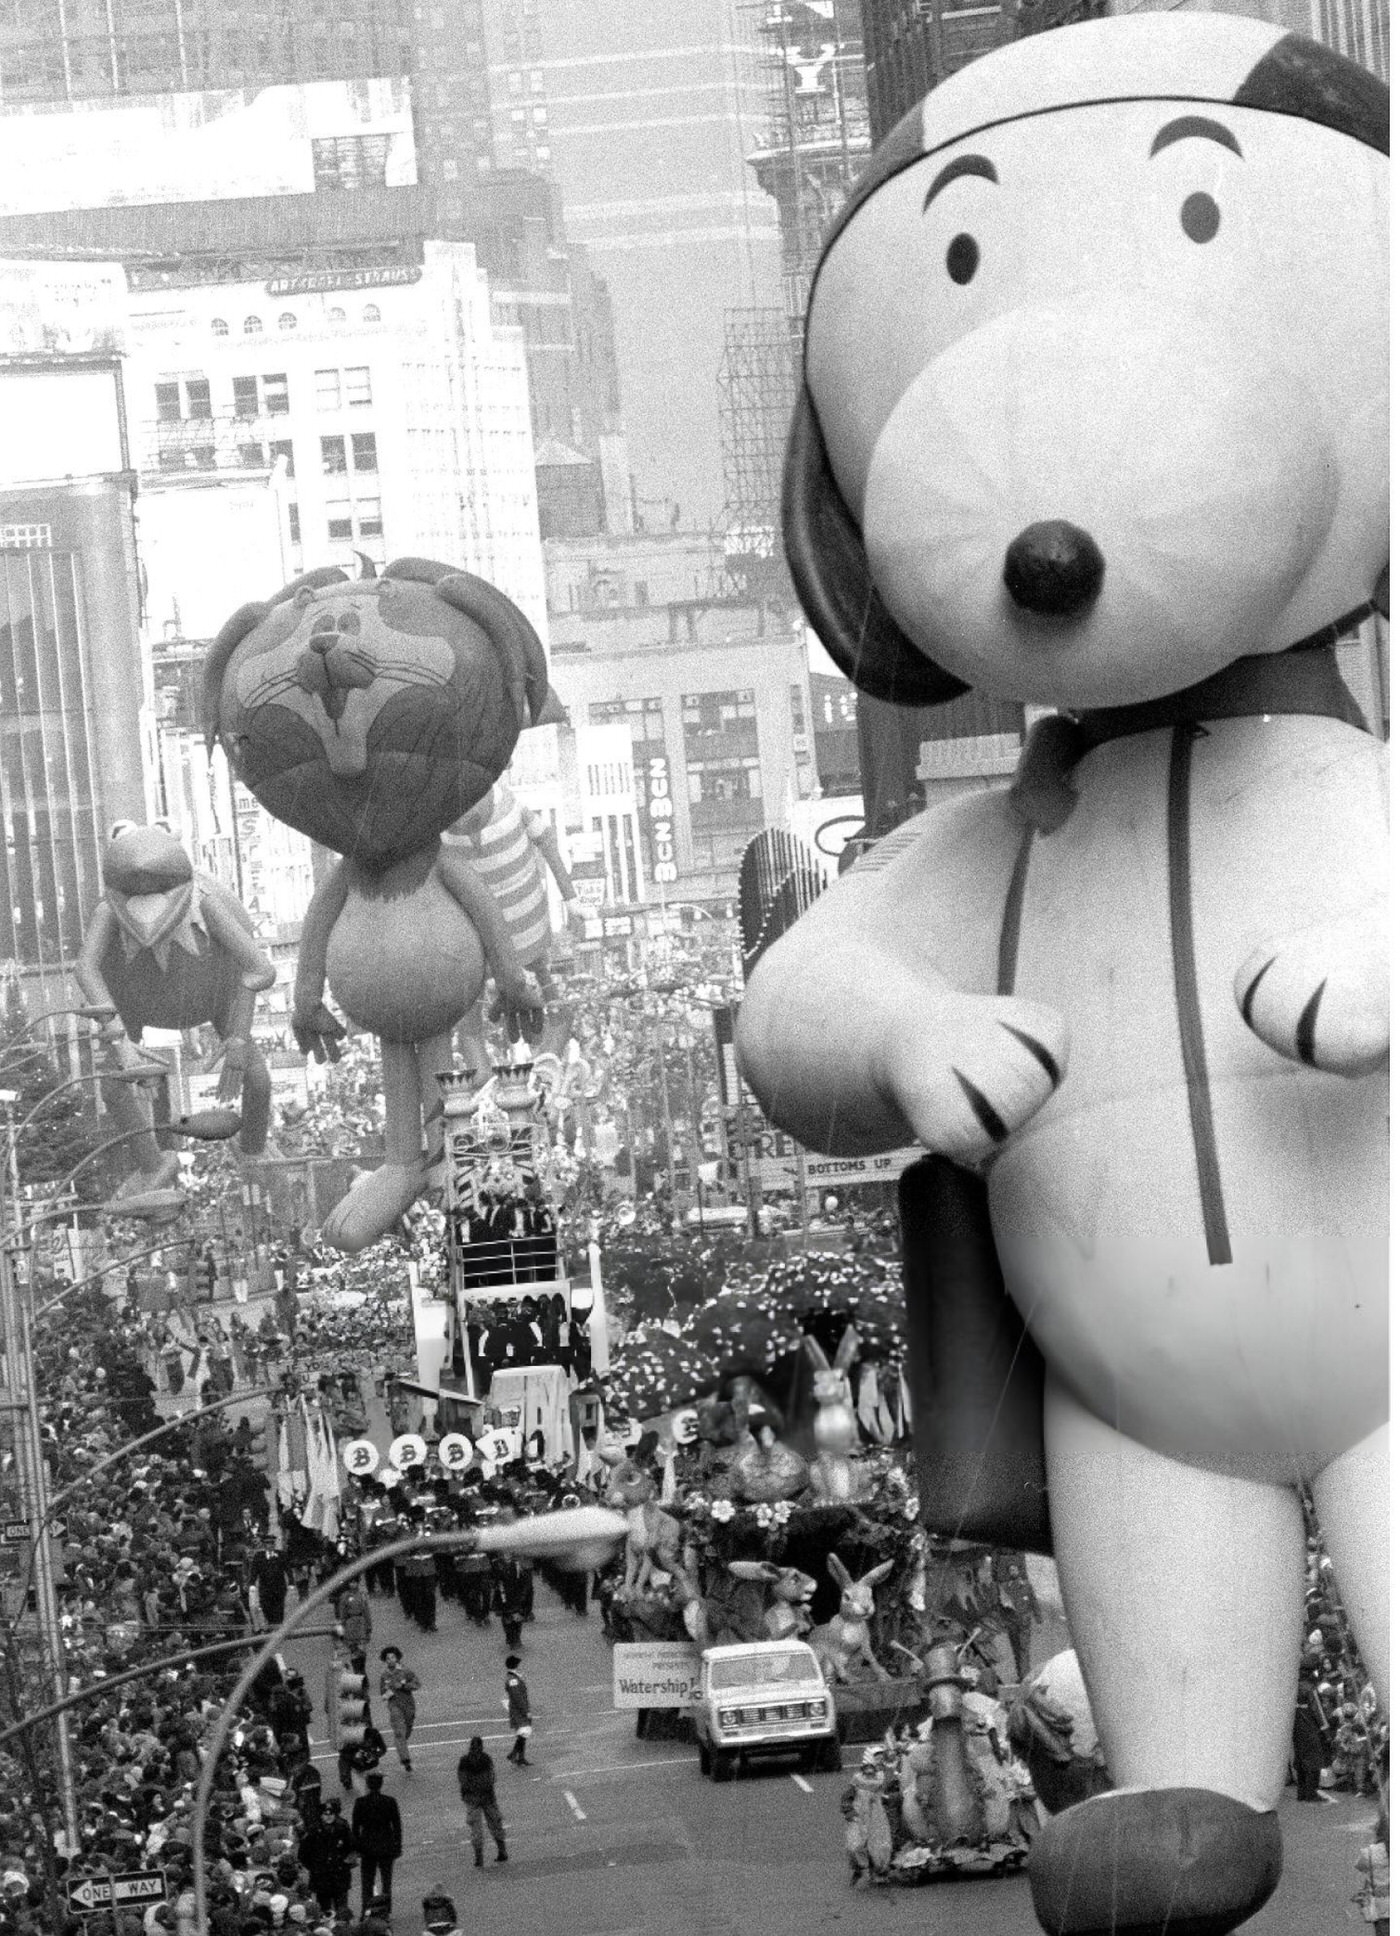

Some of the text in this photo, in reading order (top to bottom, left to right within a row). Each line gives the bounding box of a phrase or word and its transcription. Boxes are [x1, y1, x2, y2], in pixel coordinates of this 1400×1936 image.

[807, 1158, 892, 1175] BOTTOMS UP
[618, 1678, 688, 1698] Watership
[82, 1880, 157, 1901] ONE WAY
